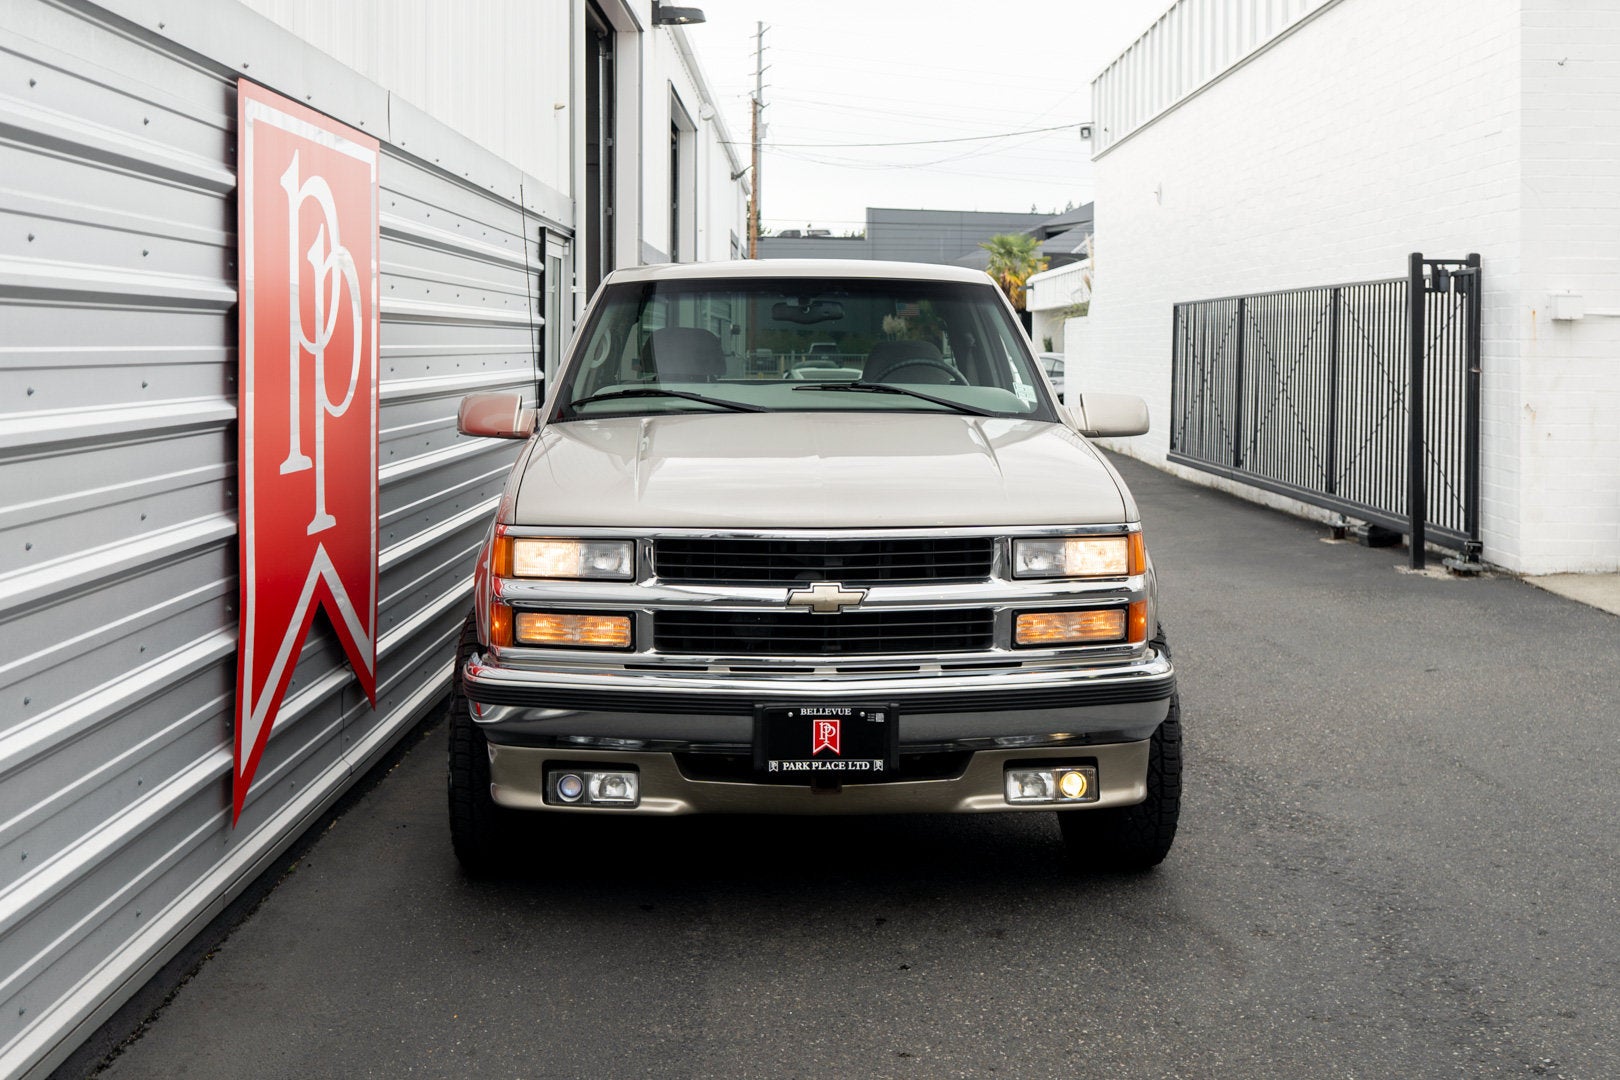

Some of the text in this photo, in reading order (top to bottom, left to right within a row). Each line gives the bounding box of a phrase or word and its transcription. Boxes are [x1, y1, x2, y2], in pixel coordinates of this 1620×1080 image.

[800, 708, 852, 716] BELLEVUE
[782, 762, 810, 771] PARK
[812, 761, 846, 770] PLACE
[848, 761, 870, 770] LTD
